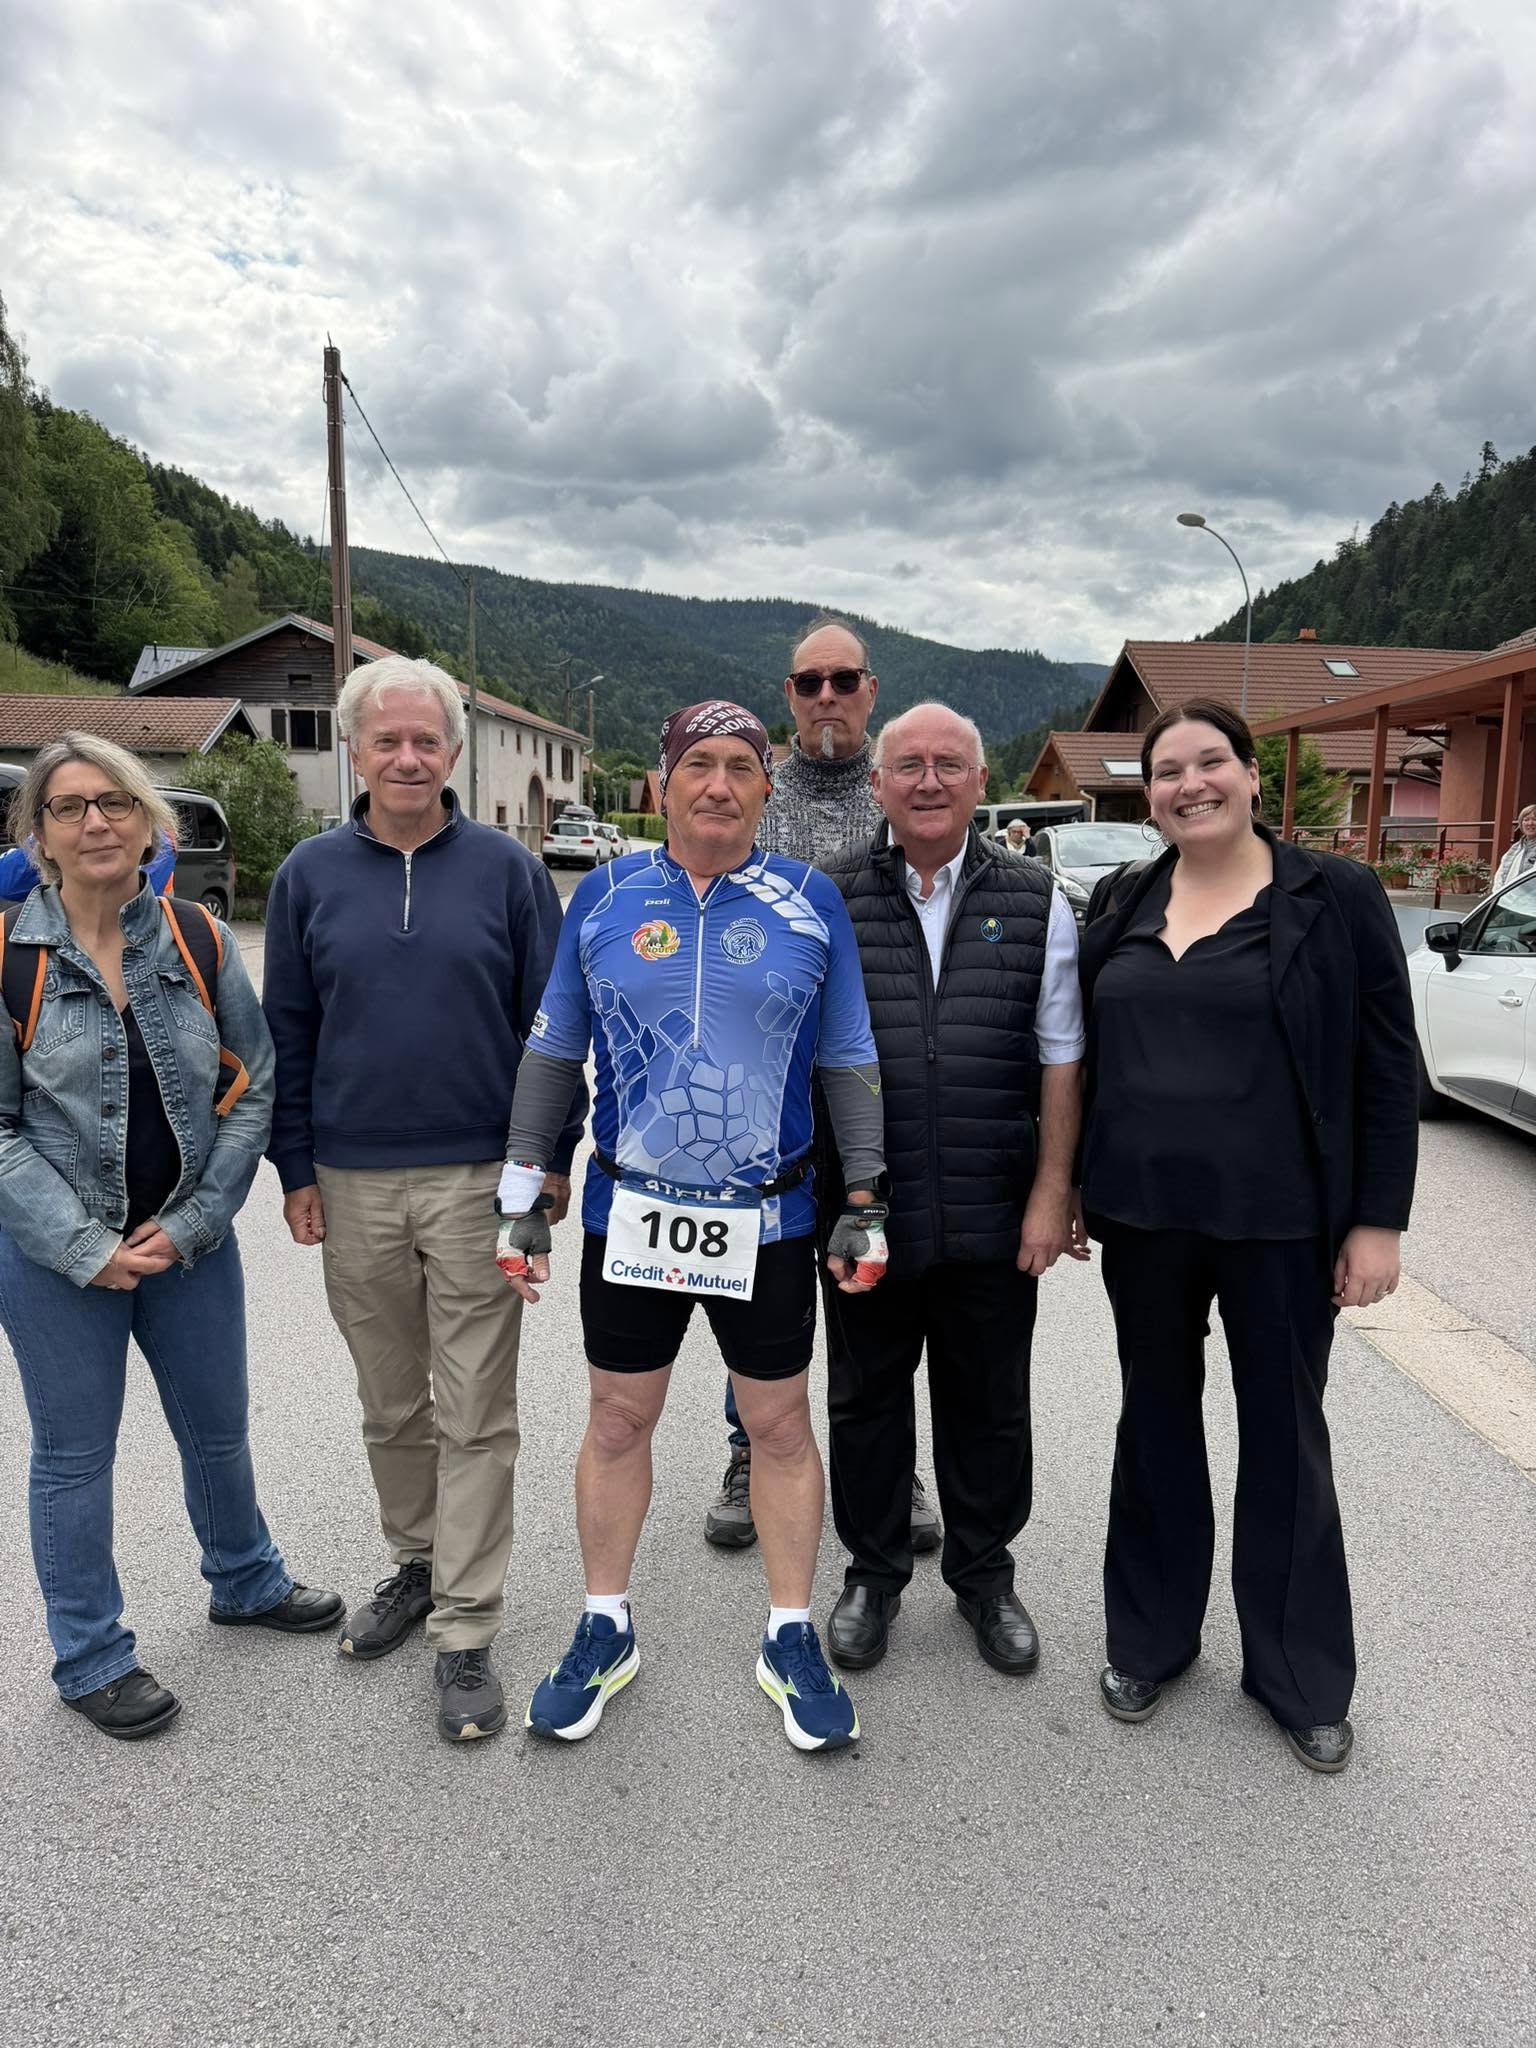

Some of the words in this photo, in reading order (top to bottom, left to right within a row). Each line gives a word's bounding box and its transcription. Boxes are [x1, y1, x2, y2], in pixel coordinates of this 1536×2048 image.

[712, 717, 749, 735] VOIS
[640, 1210, 729, 1258] 108
[610, 1259, 665, 1282] Crédit
[687, 1272, 748, 1293] Mutuel
